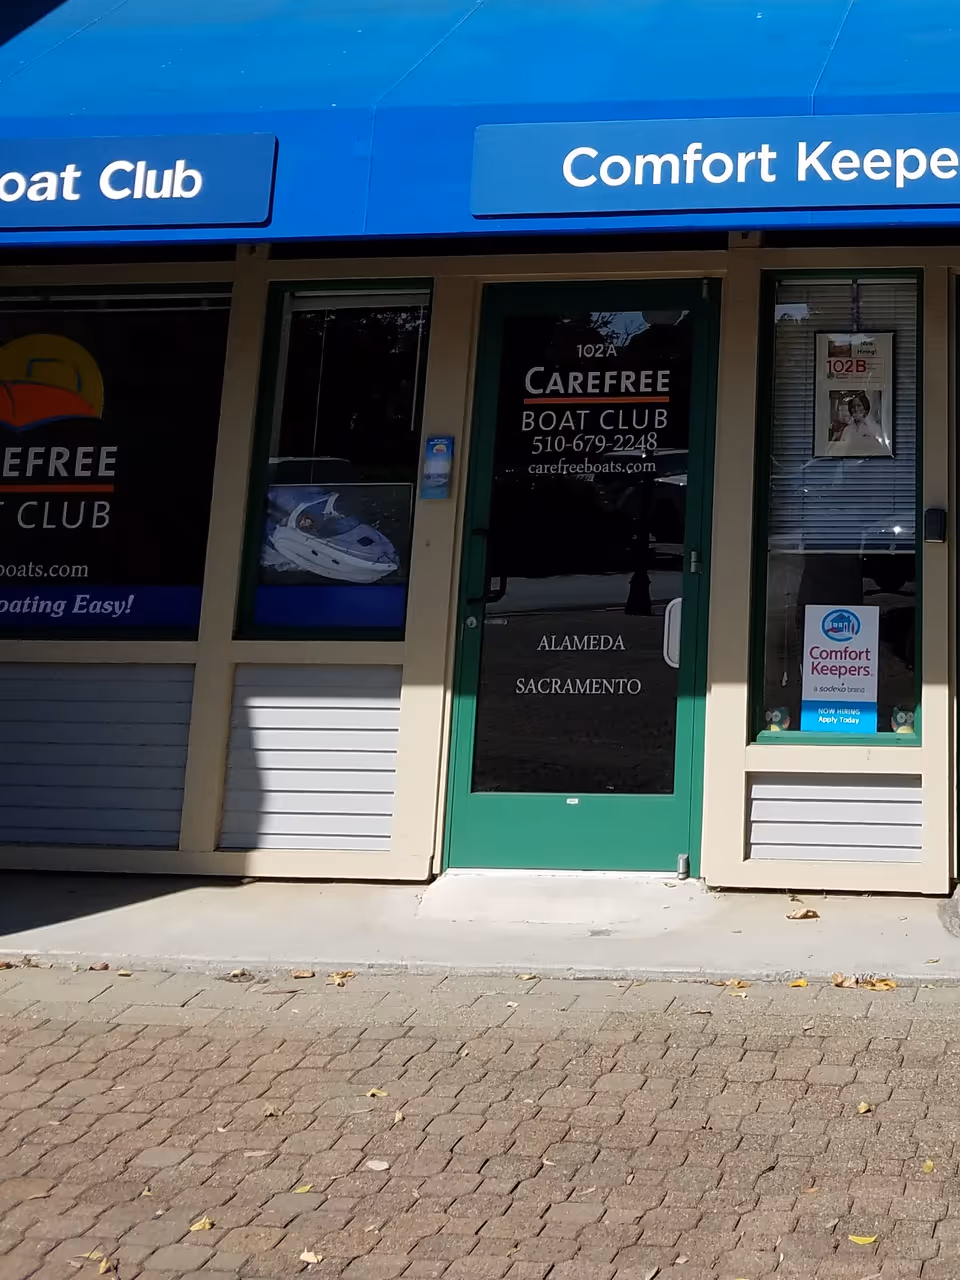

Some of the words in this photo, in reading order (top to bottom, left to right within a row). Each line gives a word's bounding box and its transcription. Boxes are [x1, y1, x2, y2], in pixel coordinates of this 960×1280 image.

[562, 142, 777, 187] Comfort
[0, 164, 81, 202] oat
[99, 159, 203, 200] Club
[576, 343, 618, 358] 102A
[525, 366, 670, 395] CAREFREE
[521, 410, 590, 431] BOAT
[600, 409, 668, 429] CLUB
[531, 431, 658, 455] 510-679-2248
[2, 446, 118, 477] EFREE
[528, 458, 657, 474] carefreeboats.com
[17, 501, 110, 529] CLUB
[71, 594, 135, 618] Easy!
[537, 635, 626, 651] ALAMEDA
[809, 646, 871, 661] Comfort
[515, 678, 642, 694] SACRAMENTO
[818, 716, 838, 724] Apply
